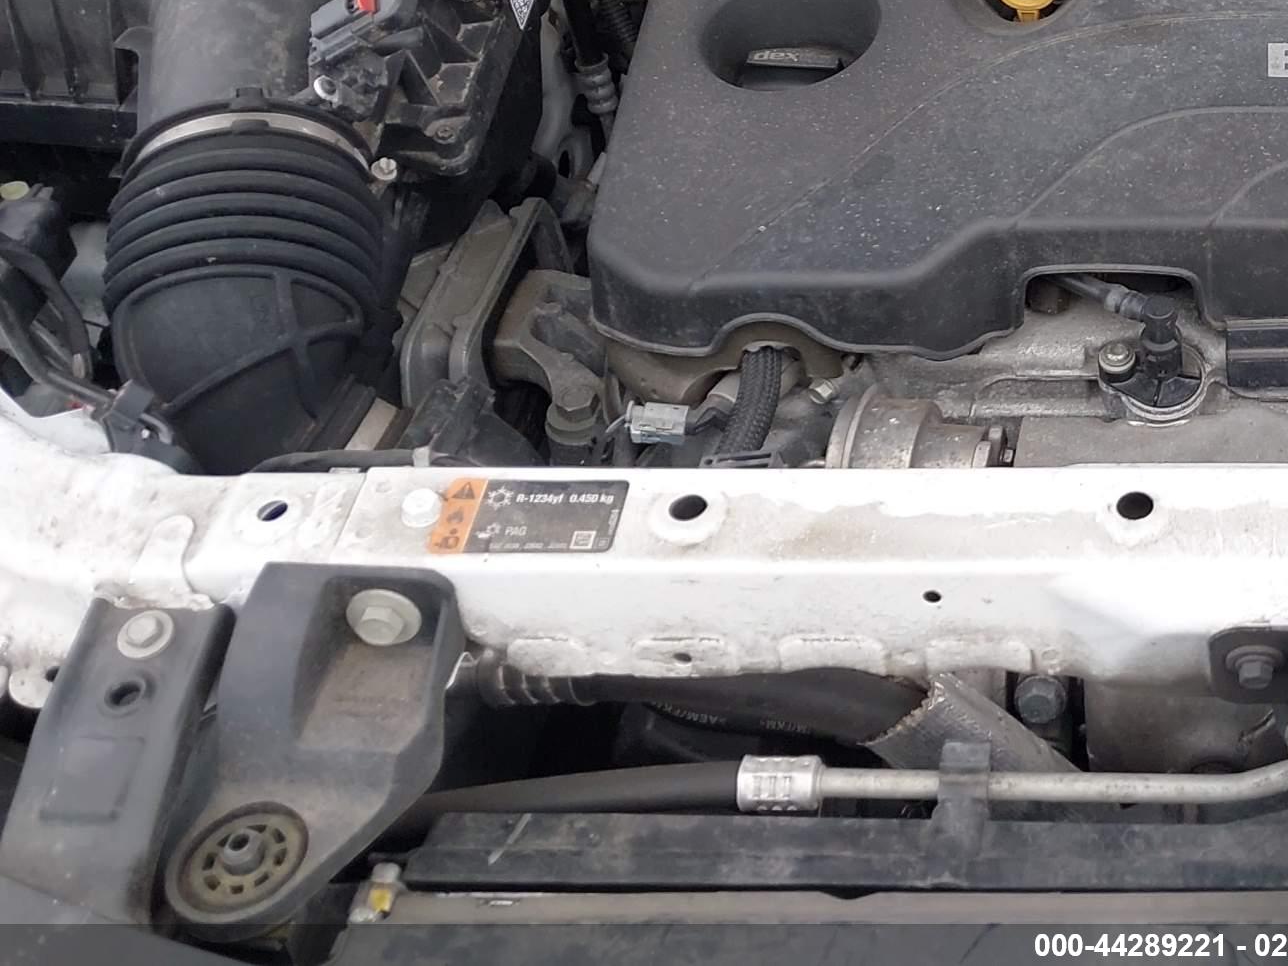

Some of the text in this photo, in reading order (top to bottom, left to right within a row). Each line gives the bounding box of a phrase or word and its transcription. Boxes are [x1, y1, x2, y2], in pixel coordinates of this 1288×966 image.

[515, 493, 565, 505] R-1234yf
[599, 493, 615, 505] kg
[504, 525, 528, 536] PAG
